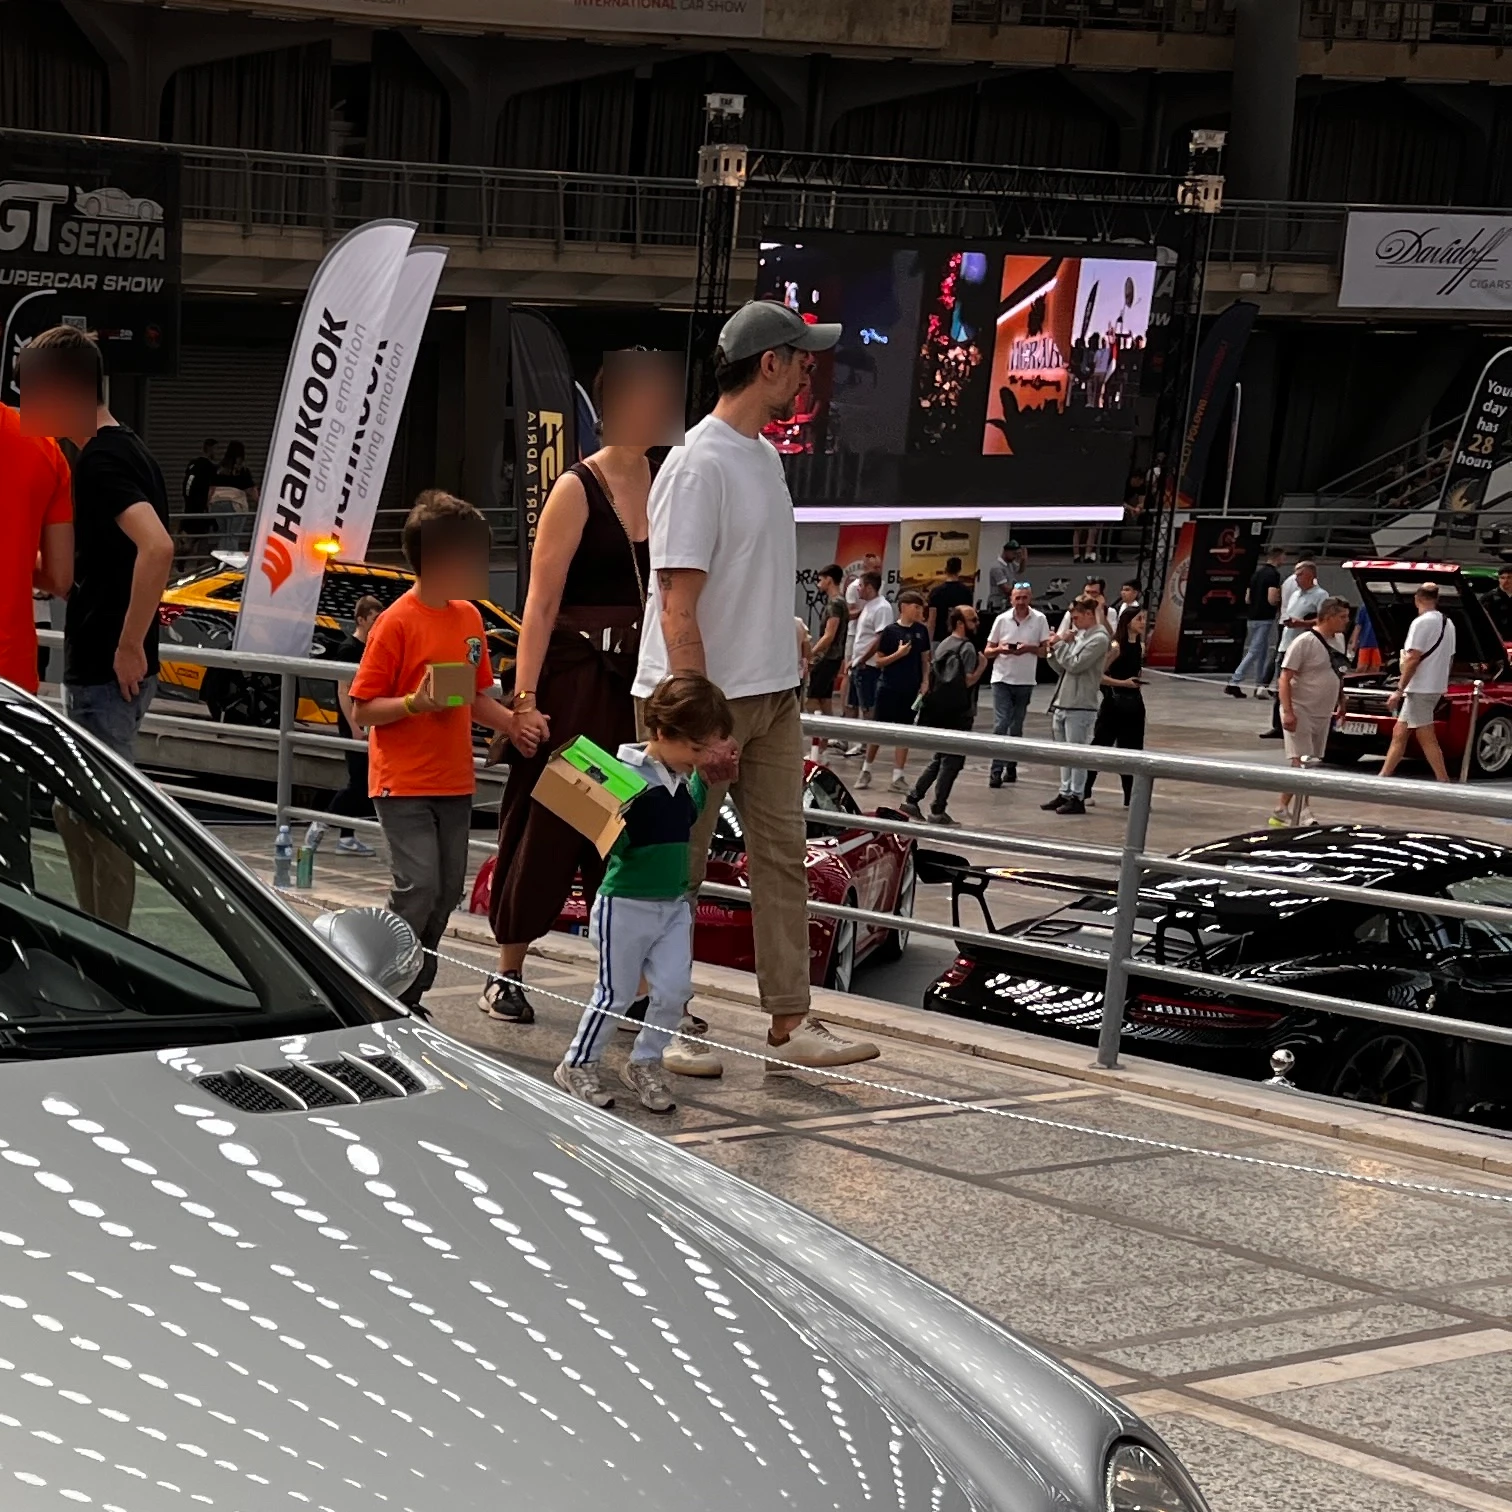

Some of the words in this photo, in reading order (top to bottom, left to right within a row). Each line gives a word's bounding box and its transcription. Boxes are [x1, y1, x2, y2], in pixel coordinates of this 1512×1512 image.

[707, 0, 746, 13] SHOW
[57, 221, 166, 260] SERBIA
[1375, 227, 1511, 295] Davidoff
[103, 275, 164, 294] SHOW
[1469, 279, 1511, 289] CIGARS
[314, 417, 346, 494] driving
[335, 322, 367, 415] emotion
[1482, 400, 1508, 418] day
[357, 428, 385, 500] driving
[375, 341, 404, 427] emotion
[1476, 416, 1499, 433] has
[1468, 433, 1495, 455] 28
[1456, 451, 1493, 470] hours
[911, 531, 938, 552] GT
